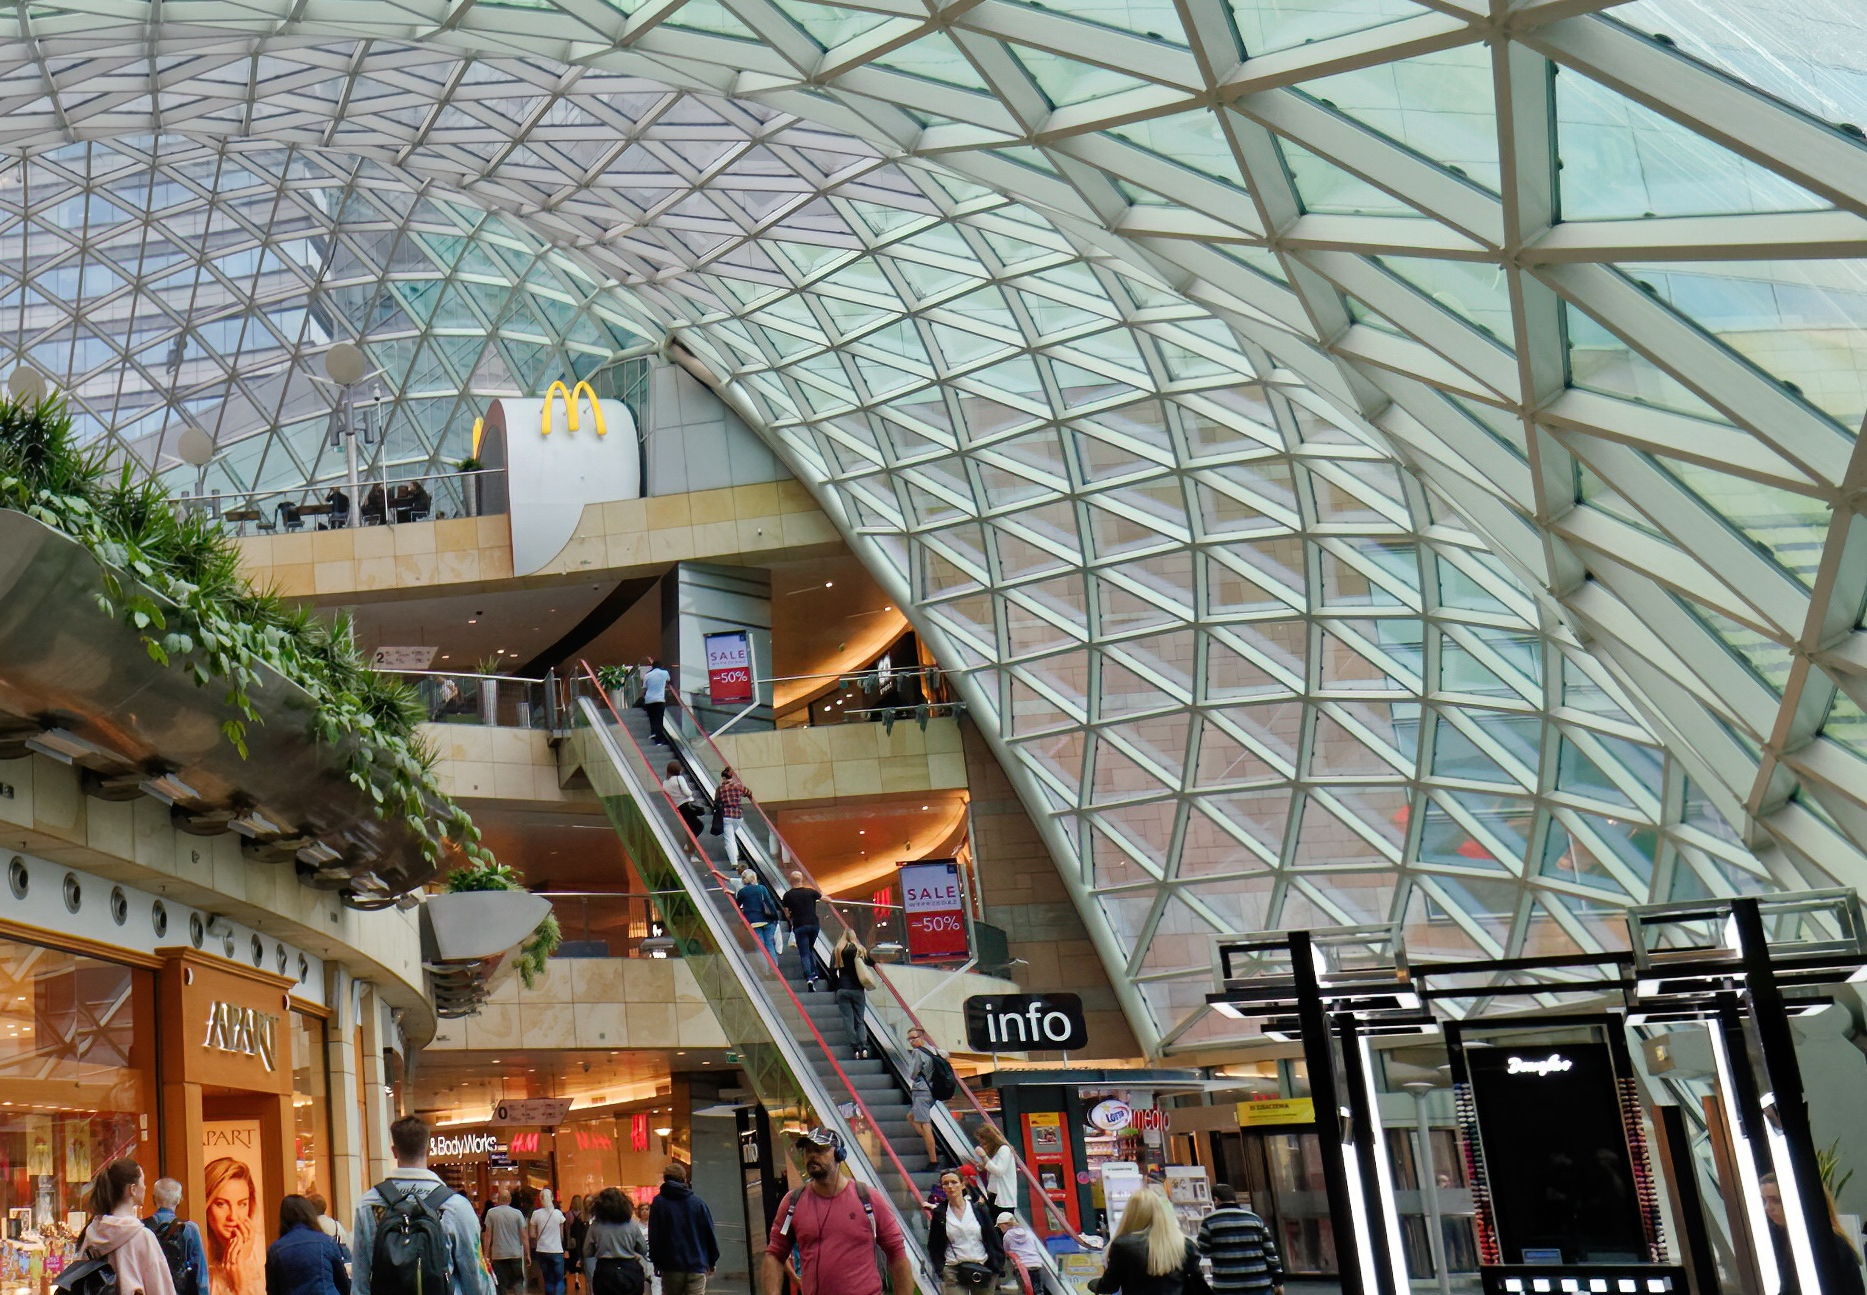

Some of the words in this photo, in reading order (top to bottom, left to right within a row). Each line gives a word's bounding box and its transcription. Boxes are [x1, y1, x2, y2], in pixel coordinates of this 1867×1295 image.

[376, 652, 385, 664] 2
[710, 650, 745, 661] SALE
[907, 886, 957, 901] SALE
[985, 1001, 1072, 1043] info
[498, 1106, 509, 1120] 0
[1127, 1109, 1171, 1132] medio
[203, 1129, 257, 1149] PART
[437, 1135, 463, 1159] Body
[463, 1132, 498, 1154] Works
